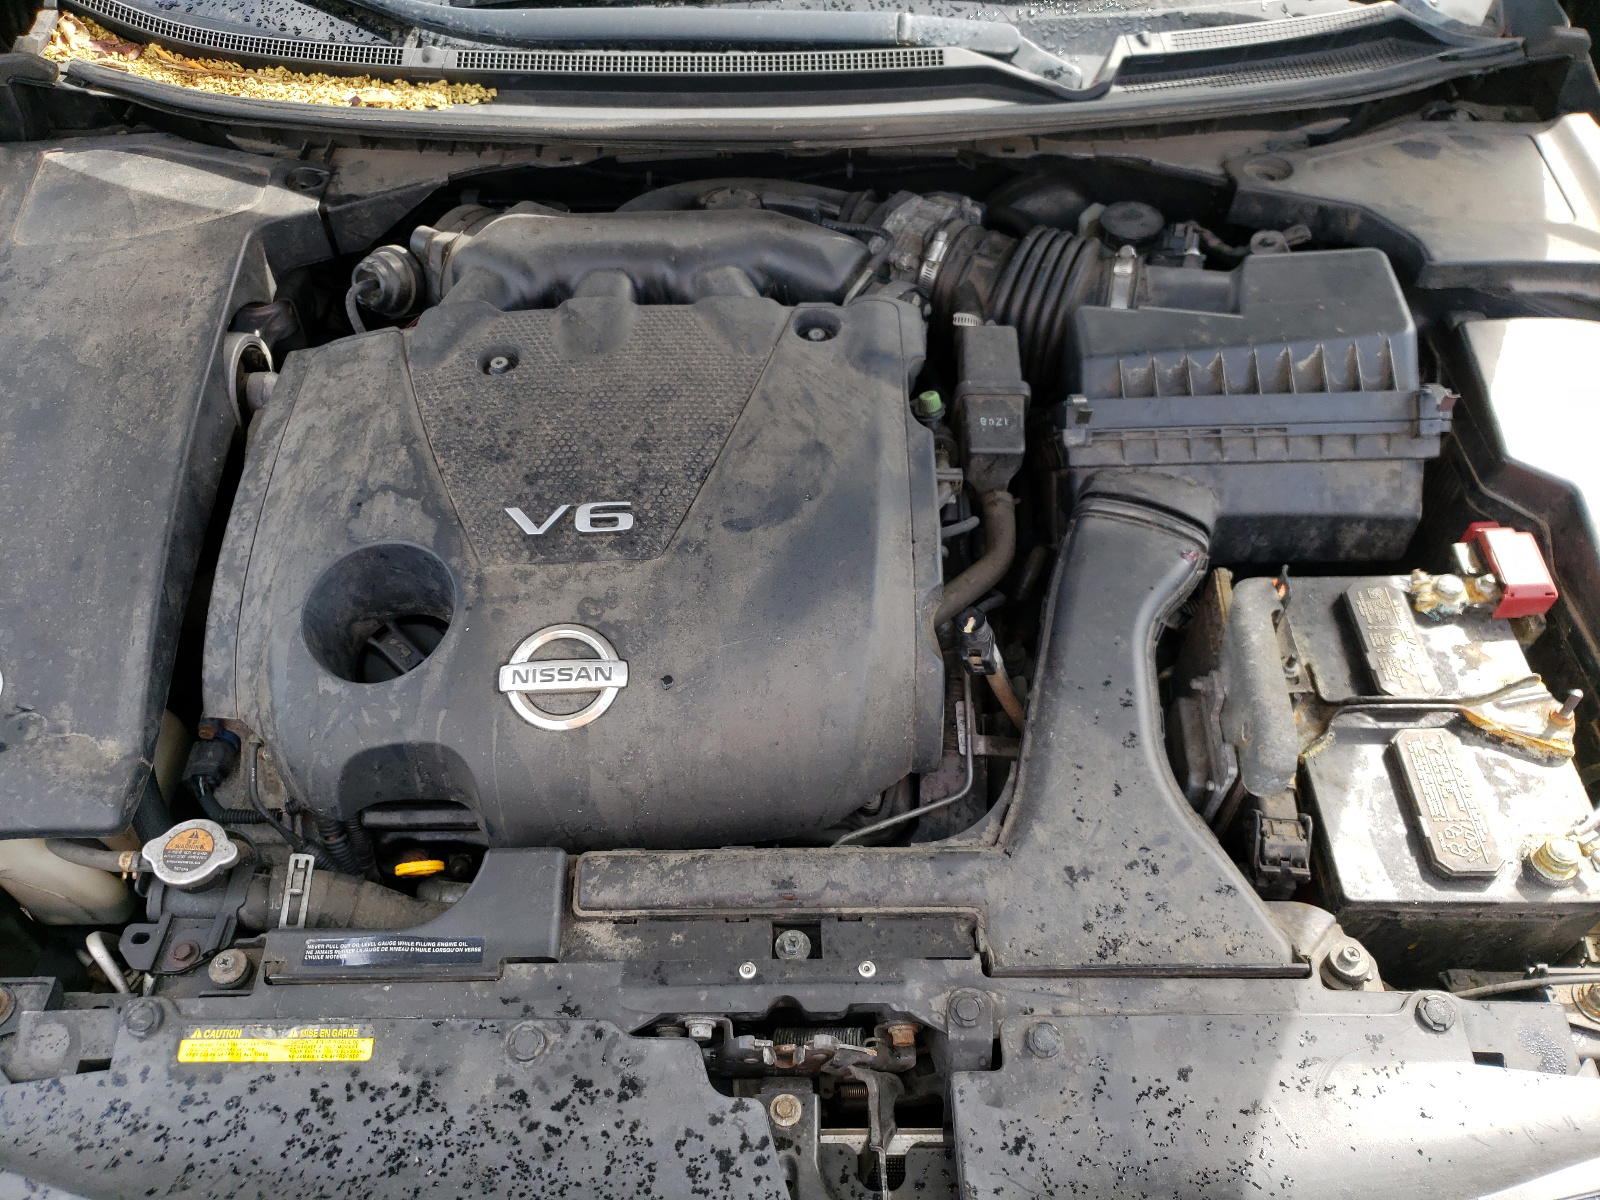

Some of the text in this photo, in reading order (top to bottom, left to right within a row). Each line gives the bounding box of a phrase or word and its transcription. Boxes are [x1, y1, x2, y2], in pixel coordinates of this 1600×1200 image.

[504, 501, 634, 535] V6
[511, 666, 614, 685] NISSAN
[203, 1028, 243, 1039] CAUTION
[319, 1028, 331, 1038] EN
[331, 1028, 359, 1038] GARDE
